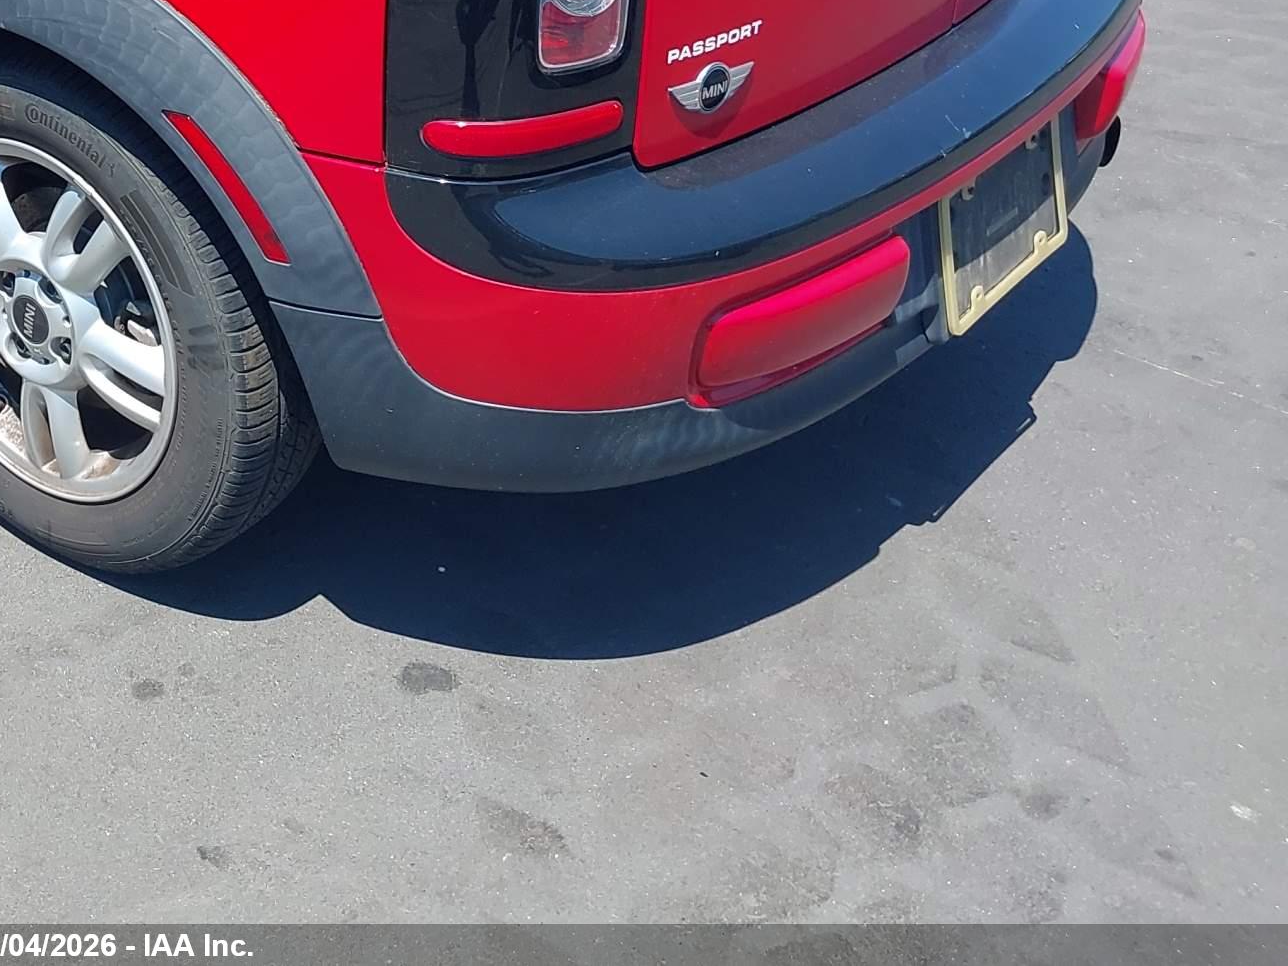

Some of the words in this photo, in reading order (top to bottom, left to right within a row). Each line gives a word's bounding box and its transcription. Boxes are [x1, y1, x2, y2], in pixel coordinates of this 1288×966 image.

[667, 19, 763, 64] PASSPORT
[702, 80, 728, 100] MINI
[24, 102, 106, 169] Continental
[23, 303, 37, 338] MINI
